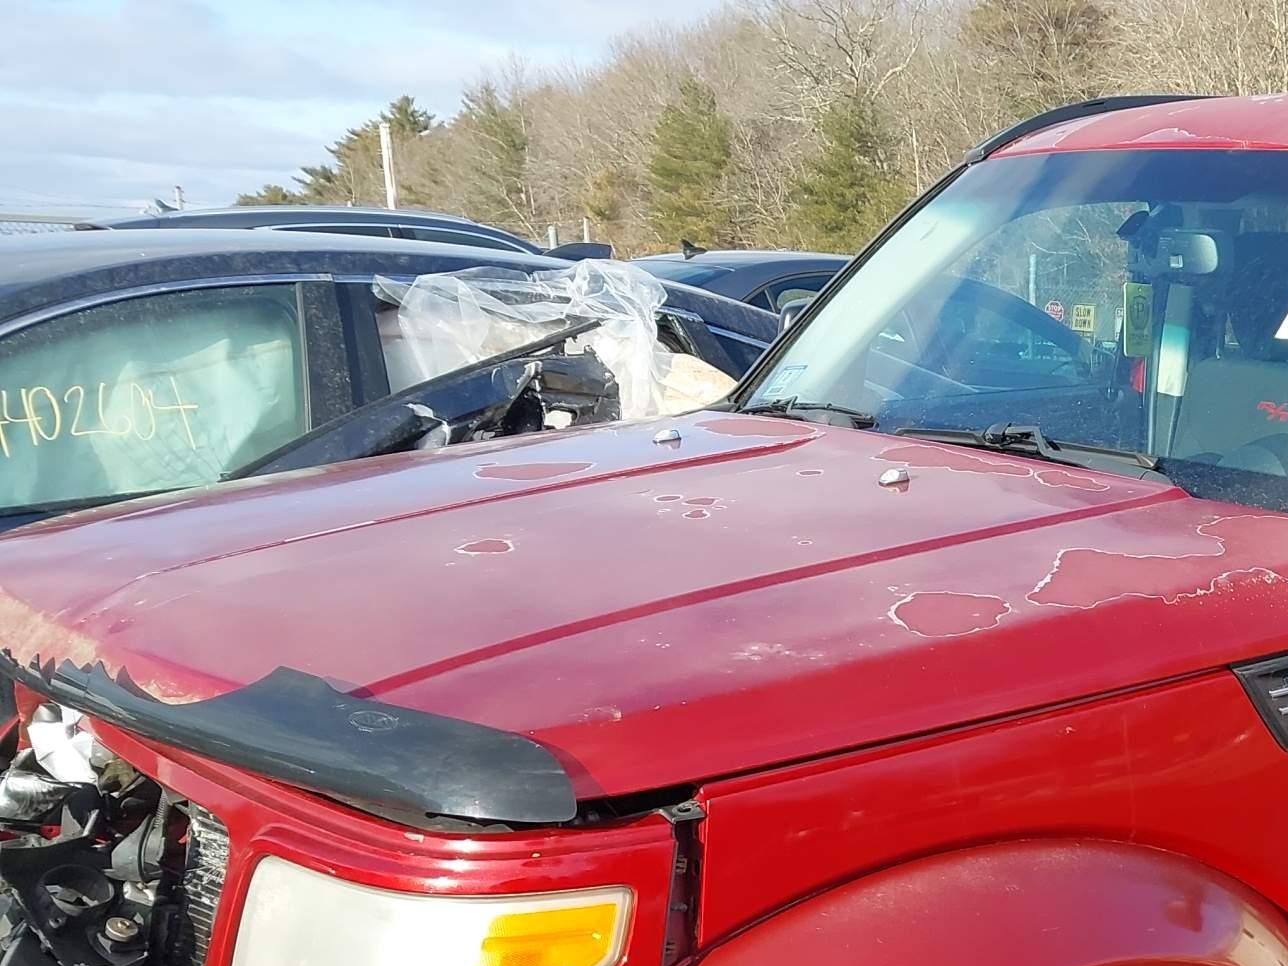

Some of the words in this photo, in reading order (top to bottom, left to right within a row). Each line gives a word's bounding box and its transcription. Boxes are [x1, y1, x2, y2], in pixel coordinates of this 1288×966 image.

[1048, 303, 1062, 313] STOP
[1075, 306, 1092, 318] SLOW
[1074, 319, 1092, 329] DOWN
